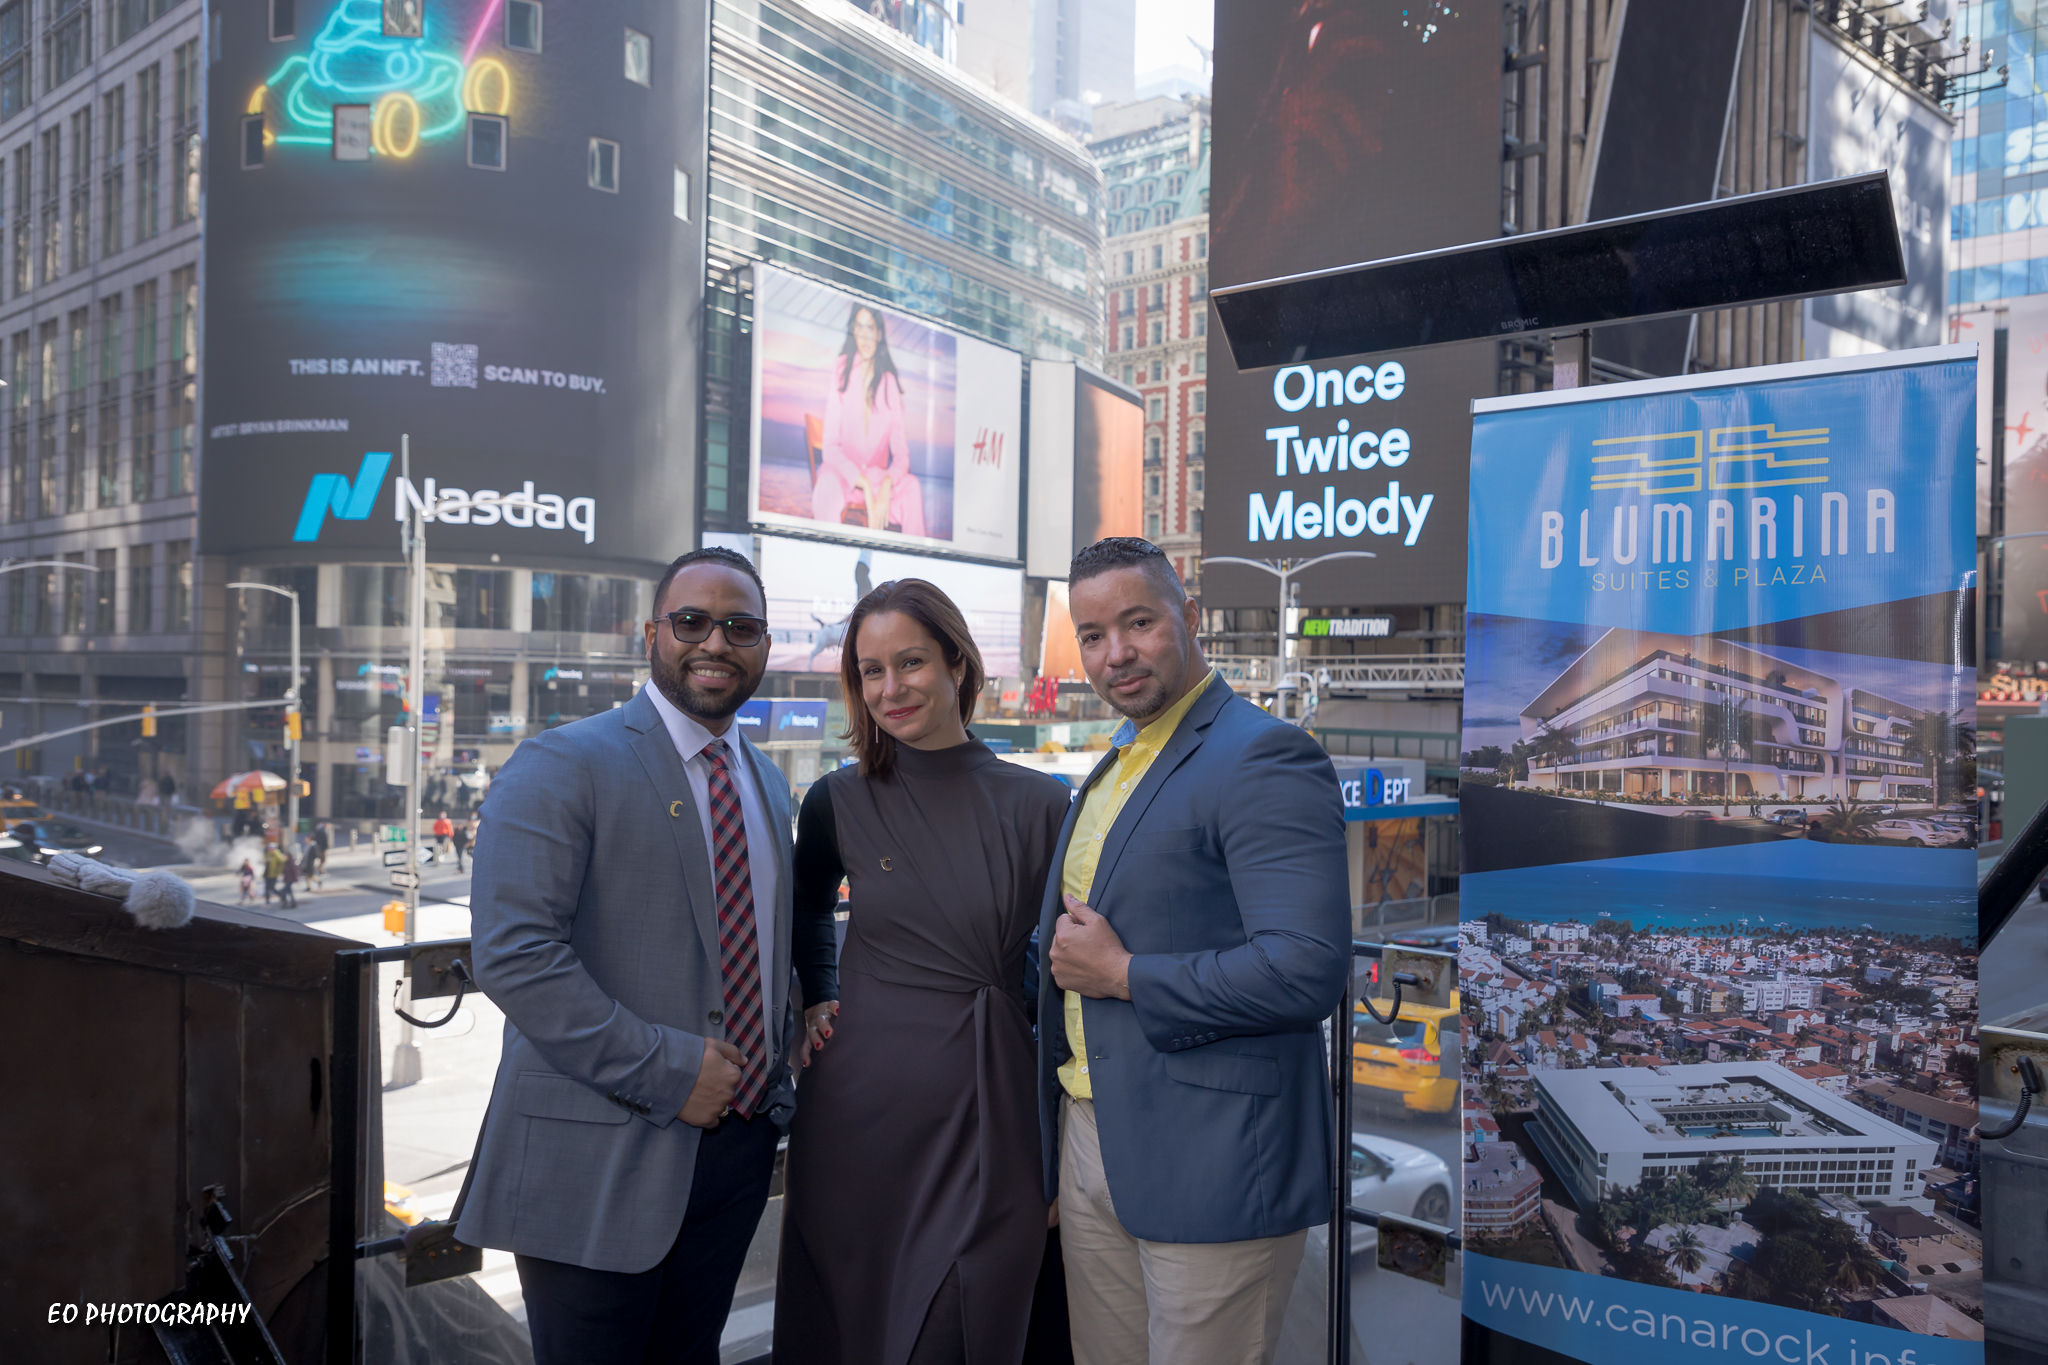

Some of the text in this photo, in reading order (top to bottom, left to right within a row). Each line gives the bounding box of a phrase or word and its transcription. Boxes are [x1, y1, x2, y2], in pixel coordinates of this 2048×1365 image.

[1500, 317, 1539, 330] BROMIC
[288, 358, 425, 377] THIS IS AN NFT.
[484, 365, 607, 394] SCAN TO BUY.
[1273, 361, 1406, 412] Once
[1265, 418, 1411, 476] Twice
[395, 477, 596, 544] Nasdaq
[1248, 481, 1434, 546] Melody
[1540, 488, 1895, 569] BLUMARINA
[1591, 564, 1827, 592] SUITES & PLAZA
[1365, 767, 1411, 806] DEPT
